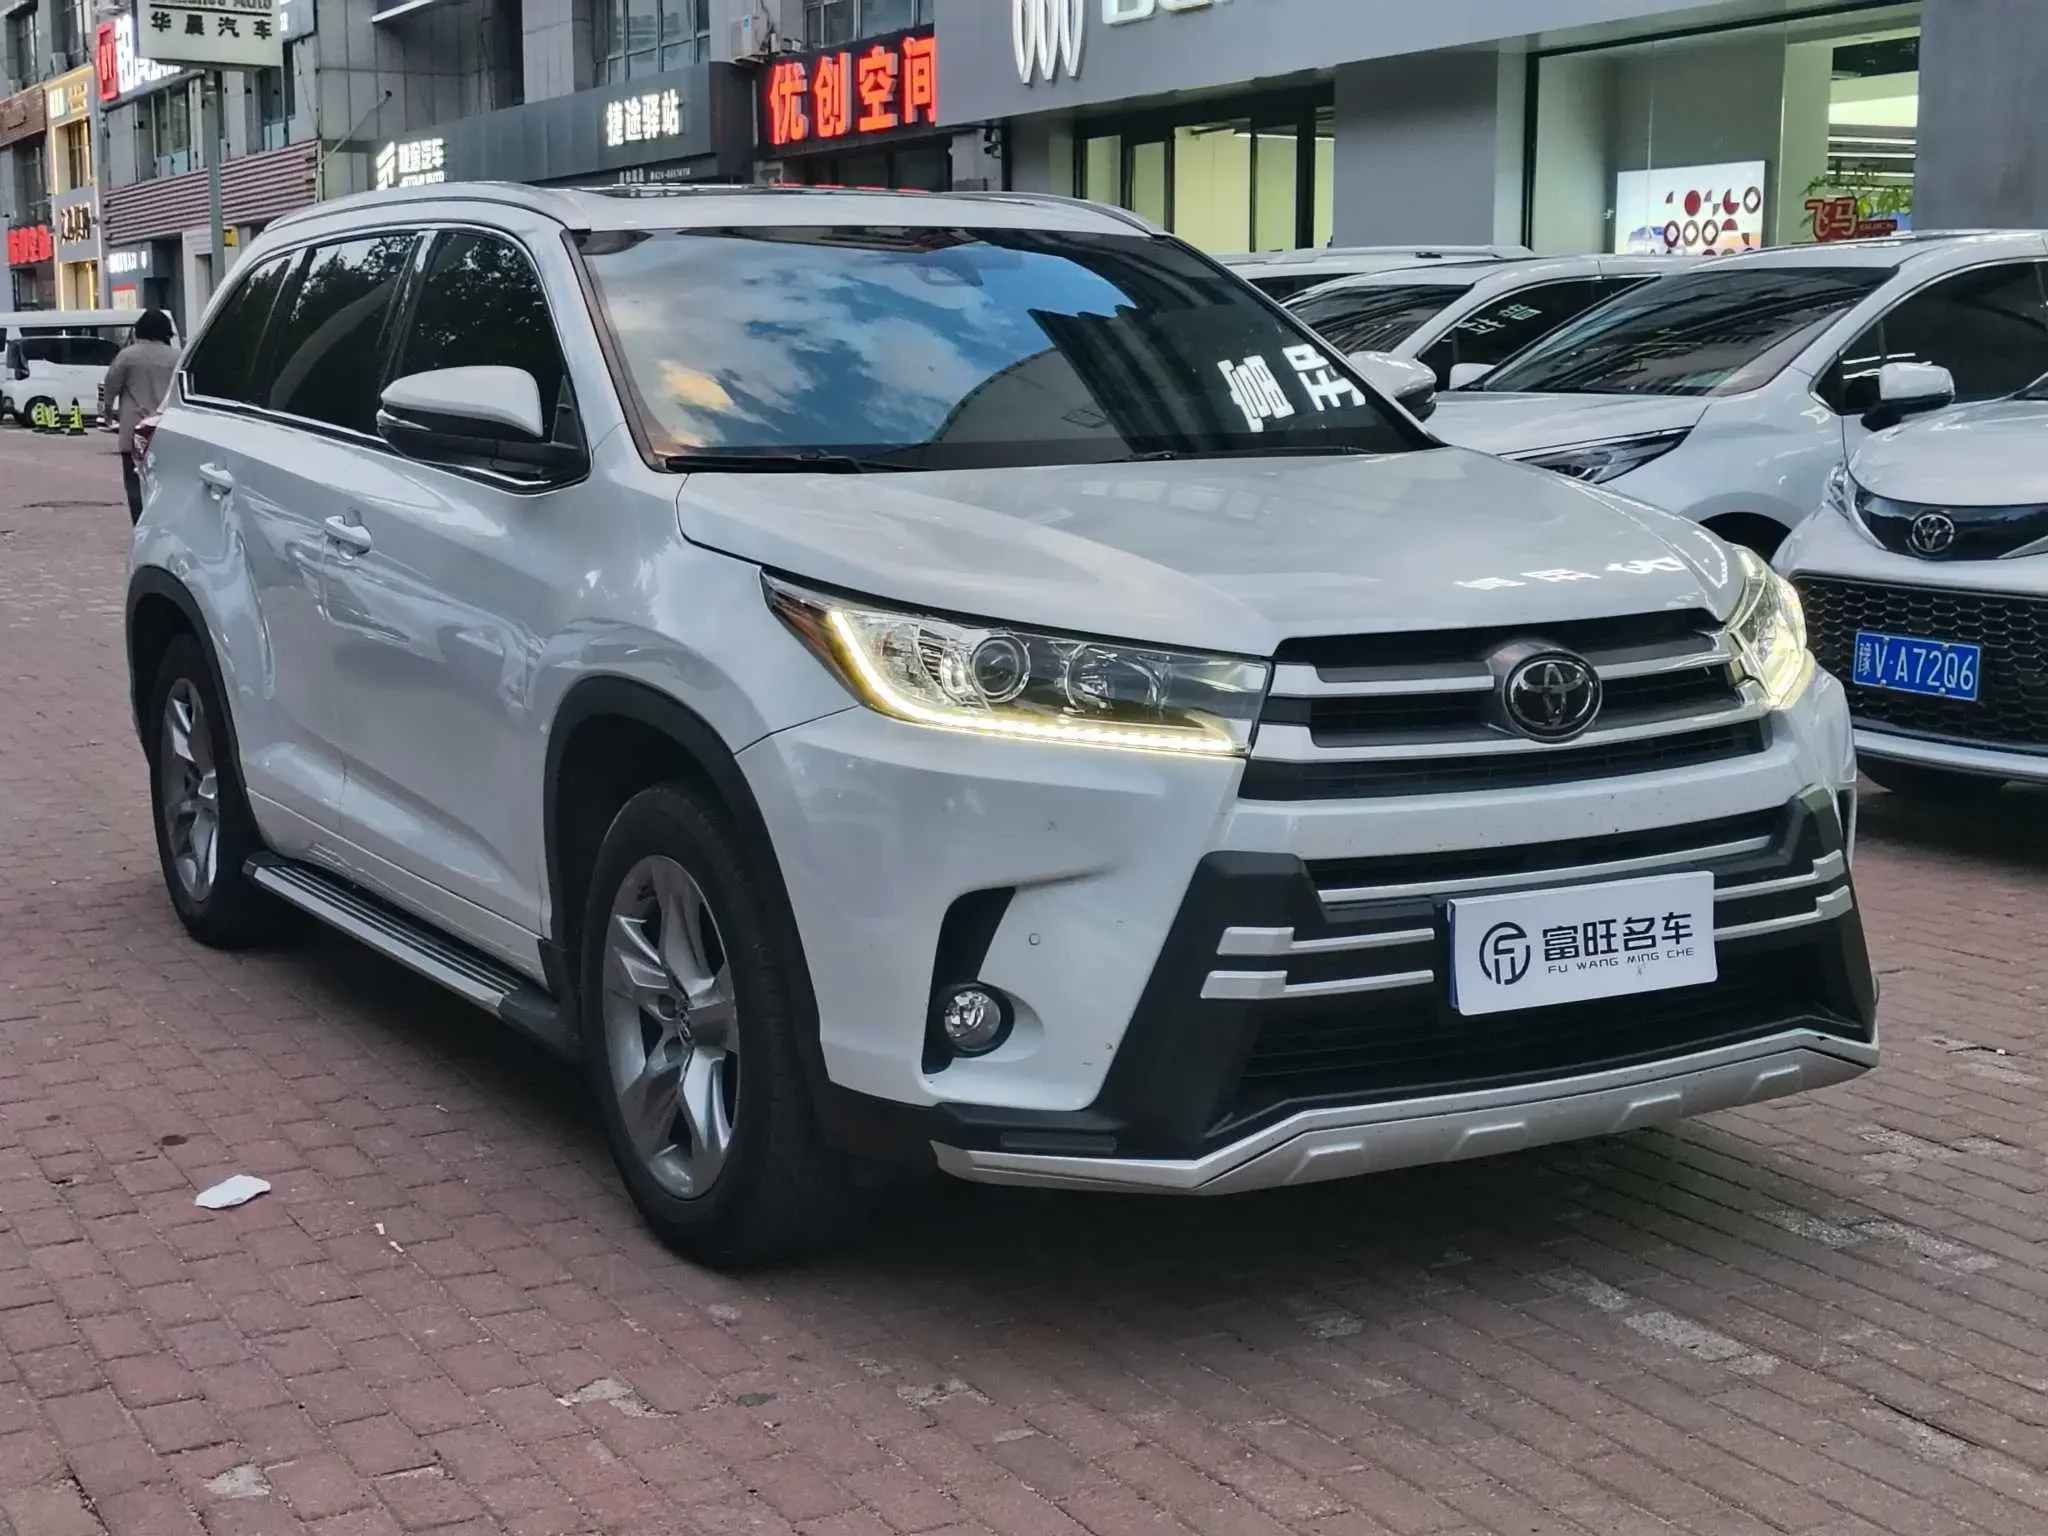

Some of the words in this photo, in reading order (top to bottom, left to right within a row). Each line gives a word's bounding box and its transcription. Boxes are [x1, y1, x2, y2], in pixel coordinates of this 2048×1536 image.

[151, 11, 272, 40] 华晨汽车
[769, 36, 936, 145] 优创空间
[1805, 198, 1857, 237] 飞马
[1542, 911, 1694, 962] 富旺名车
[1548, 962, 1568, 974] FU
[1577, 957, 1619, 970] WANG
[1626, 951, 1660, 964] MING
[1667, 947, 1694, 959] CHE
